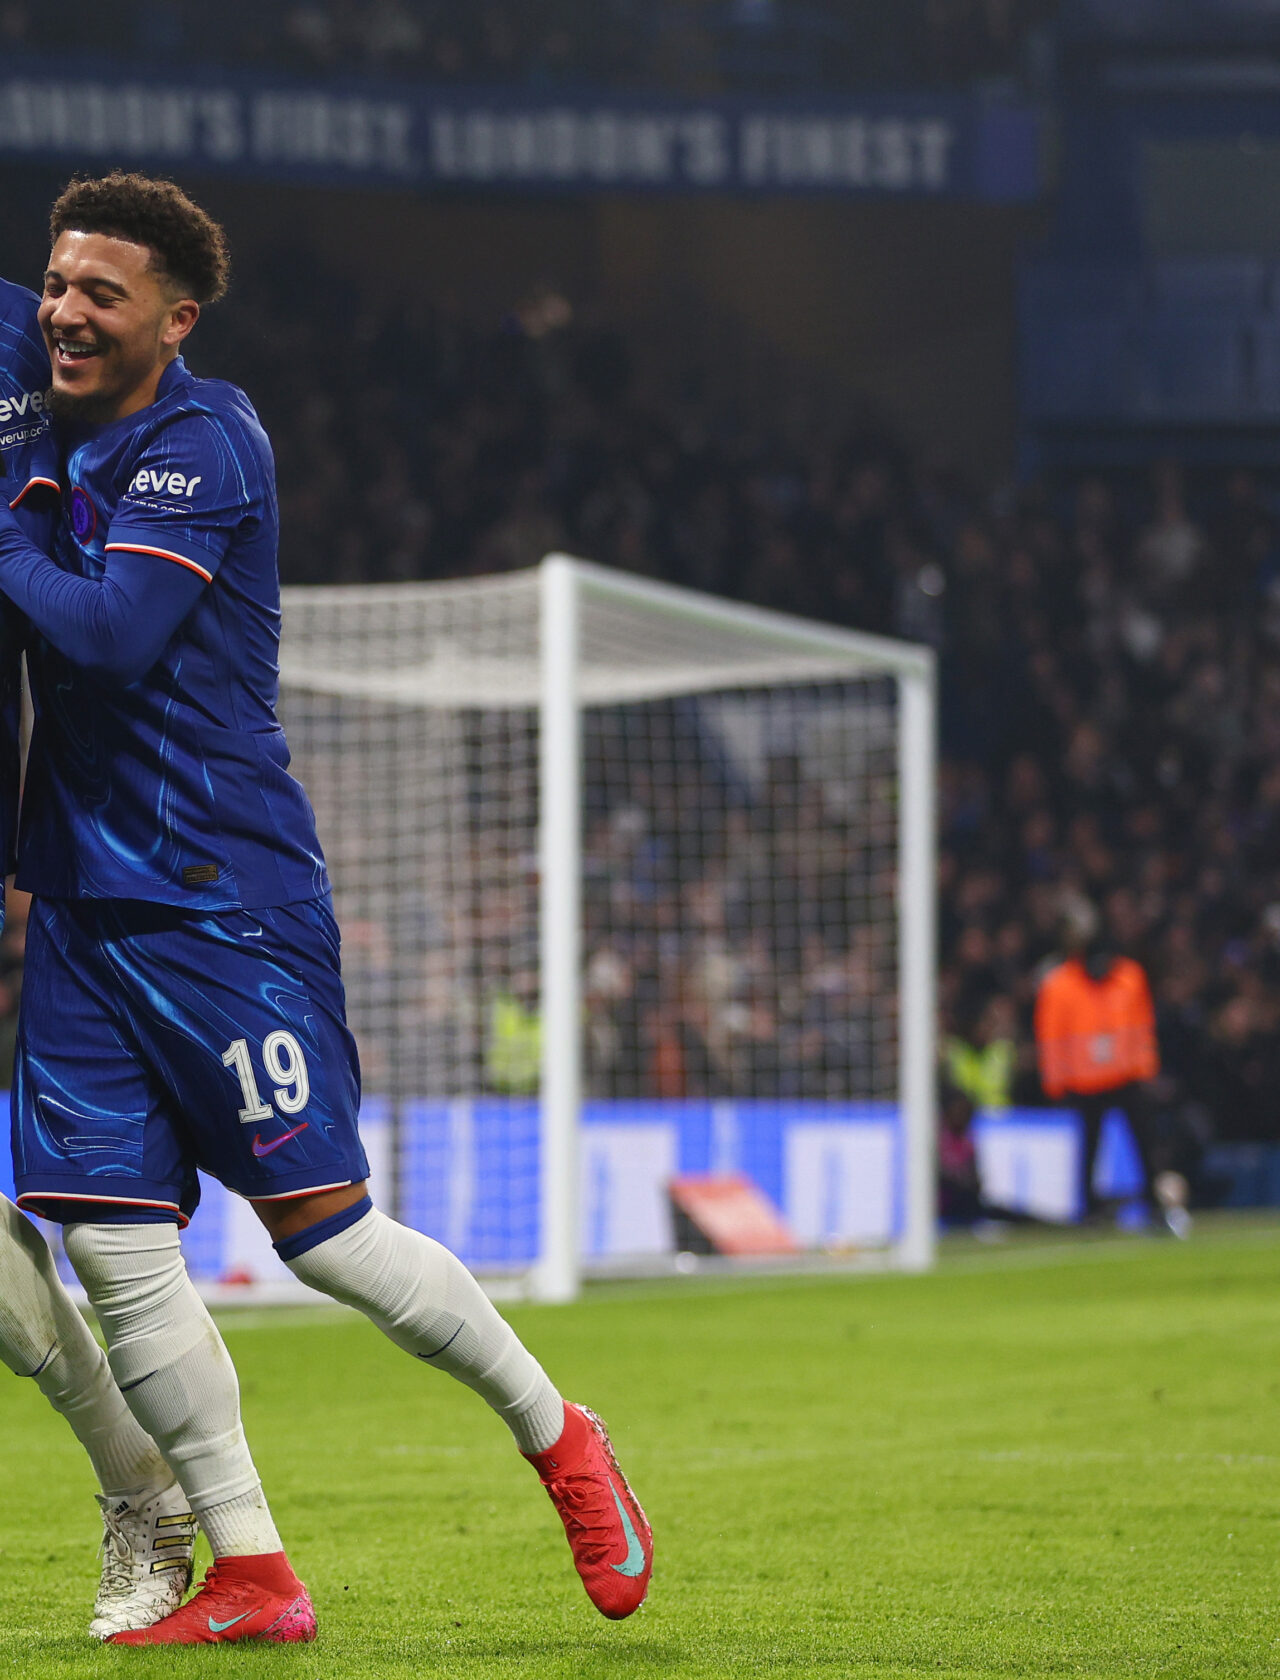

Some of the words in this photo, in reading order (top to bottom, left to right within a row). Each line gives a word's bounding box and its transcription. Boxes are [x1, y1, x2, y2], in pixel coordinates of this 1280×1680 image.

[429, 106, 727, 183] LONDON'S
[741, 114, 954, 191] FINEST
[222, 1029, 310, 1124] 19
